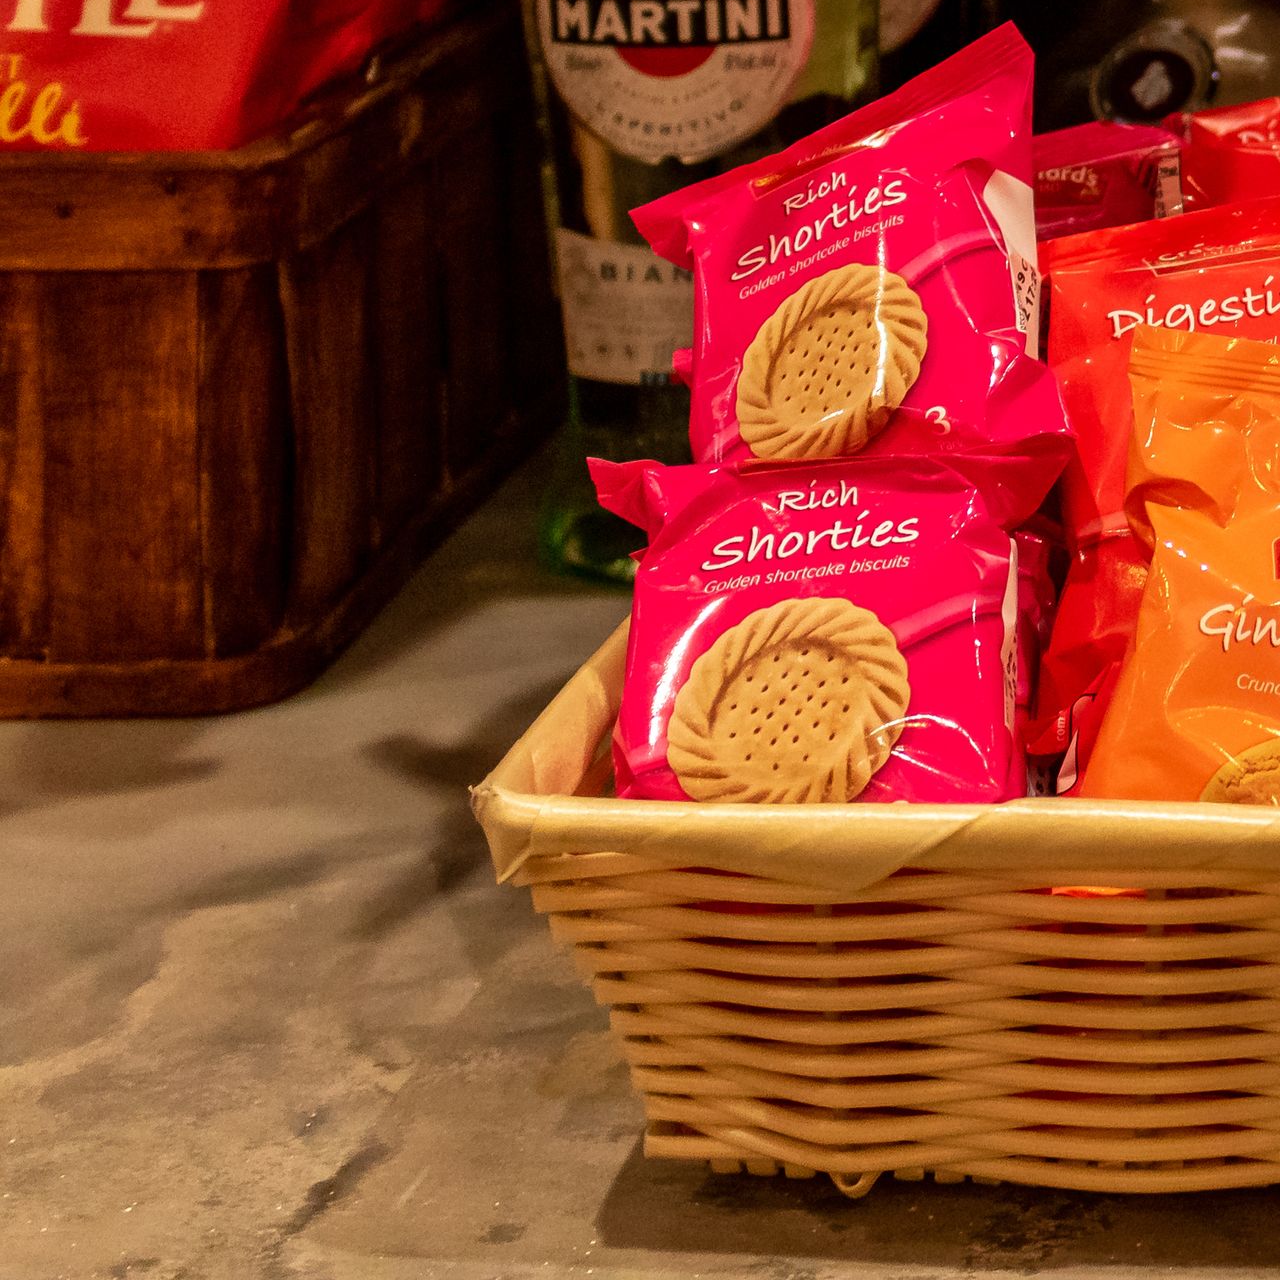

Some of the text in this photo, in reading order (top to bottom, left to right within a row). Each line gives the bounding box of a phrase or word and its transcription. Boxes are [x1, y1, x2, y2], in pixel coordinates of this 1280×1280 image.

[782, 170, 848, 216] Rich
[731, 178, 908, 282] Shorties
[738, 214, 905, 300] Golden shortcake biscuits
[777, 479, 859, 513] Rich
[701, 511, 920, 572] Shorties
[703, 553, 911, 596] Golden shortcake biscuits
